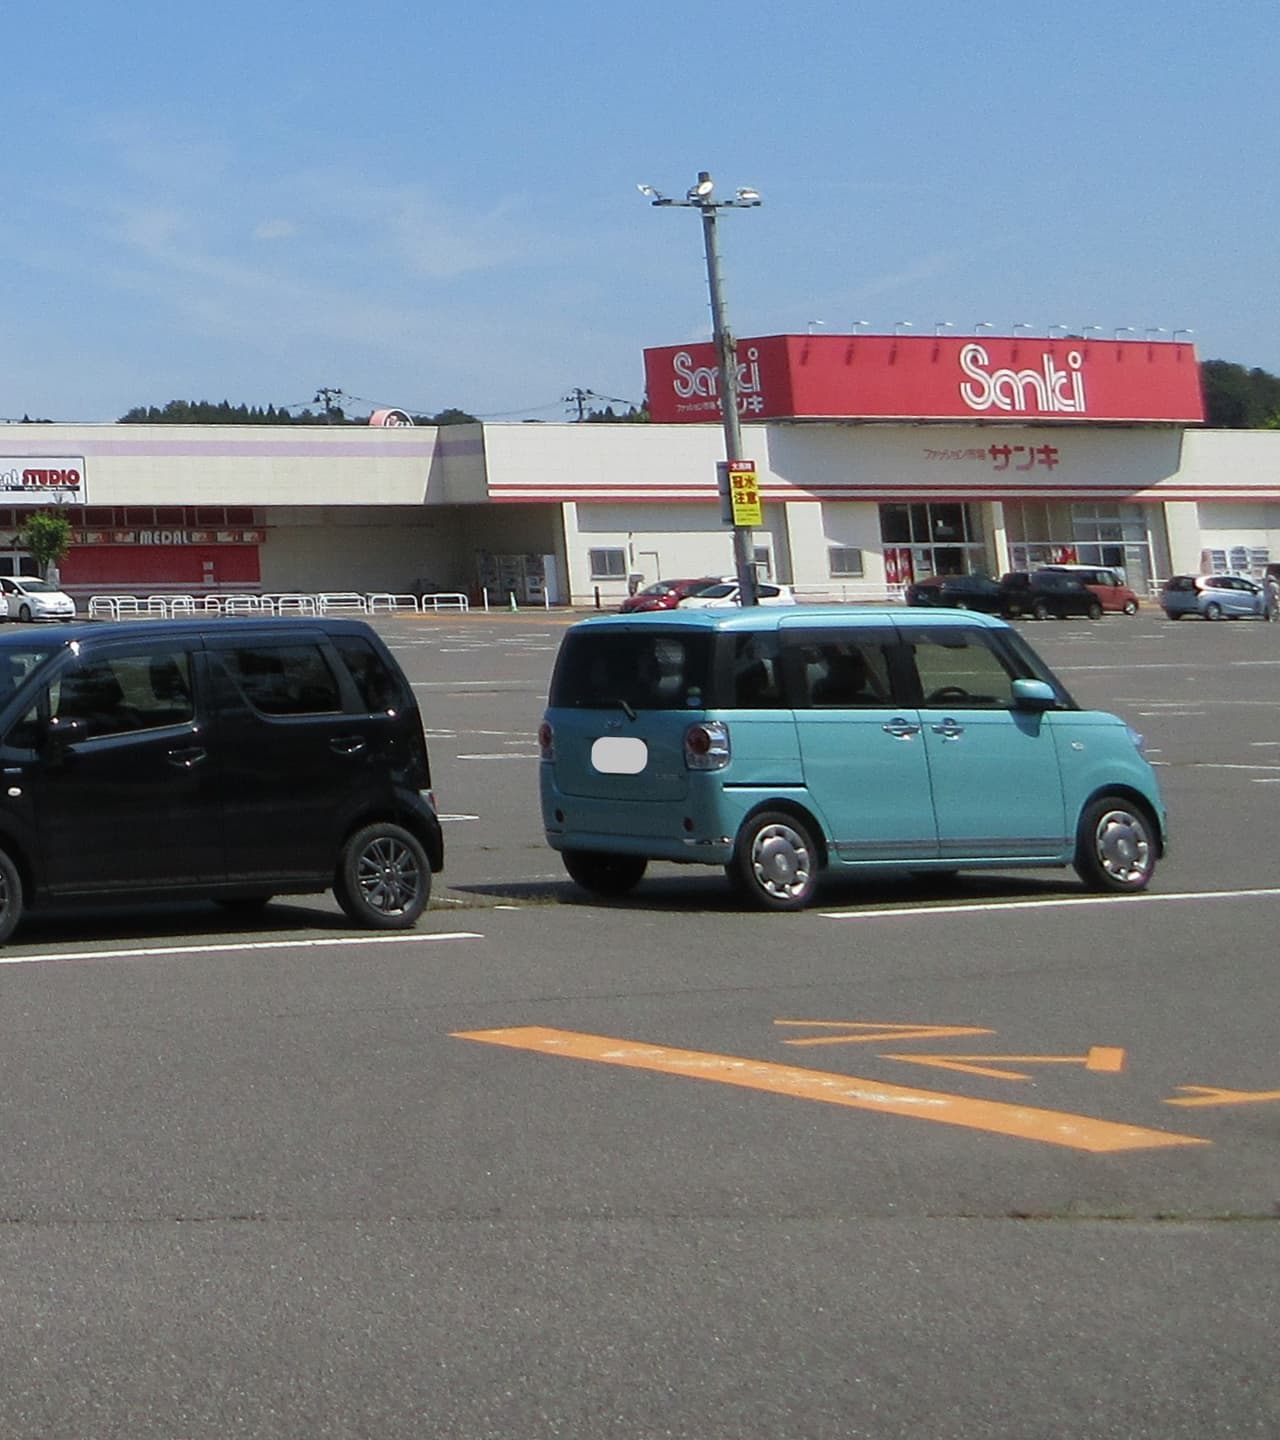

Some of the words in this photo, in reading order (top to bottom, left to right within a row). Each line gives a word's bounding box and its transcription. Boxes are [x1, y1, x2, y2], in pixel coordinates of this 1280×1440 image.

[673, 347, 761, 398] Saki
[960, 343, 1086, 412] Sanki
[988, 444, 1060, 472] サンキ
[22, 469, 80, 486] STUDIO
[139, 530, 190, 545] MEDAL
